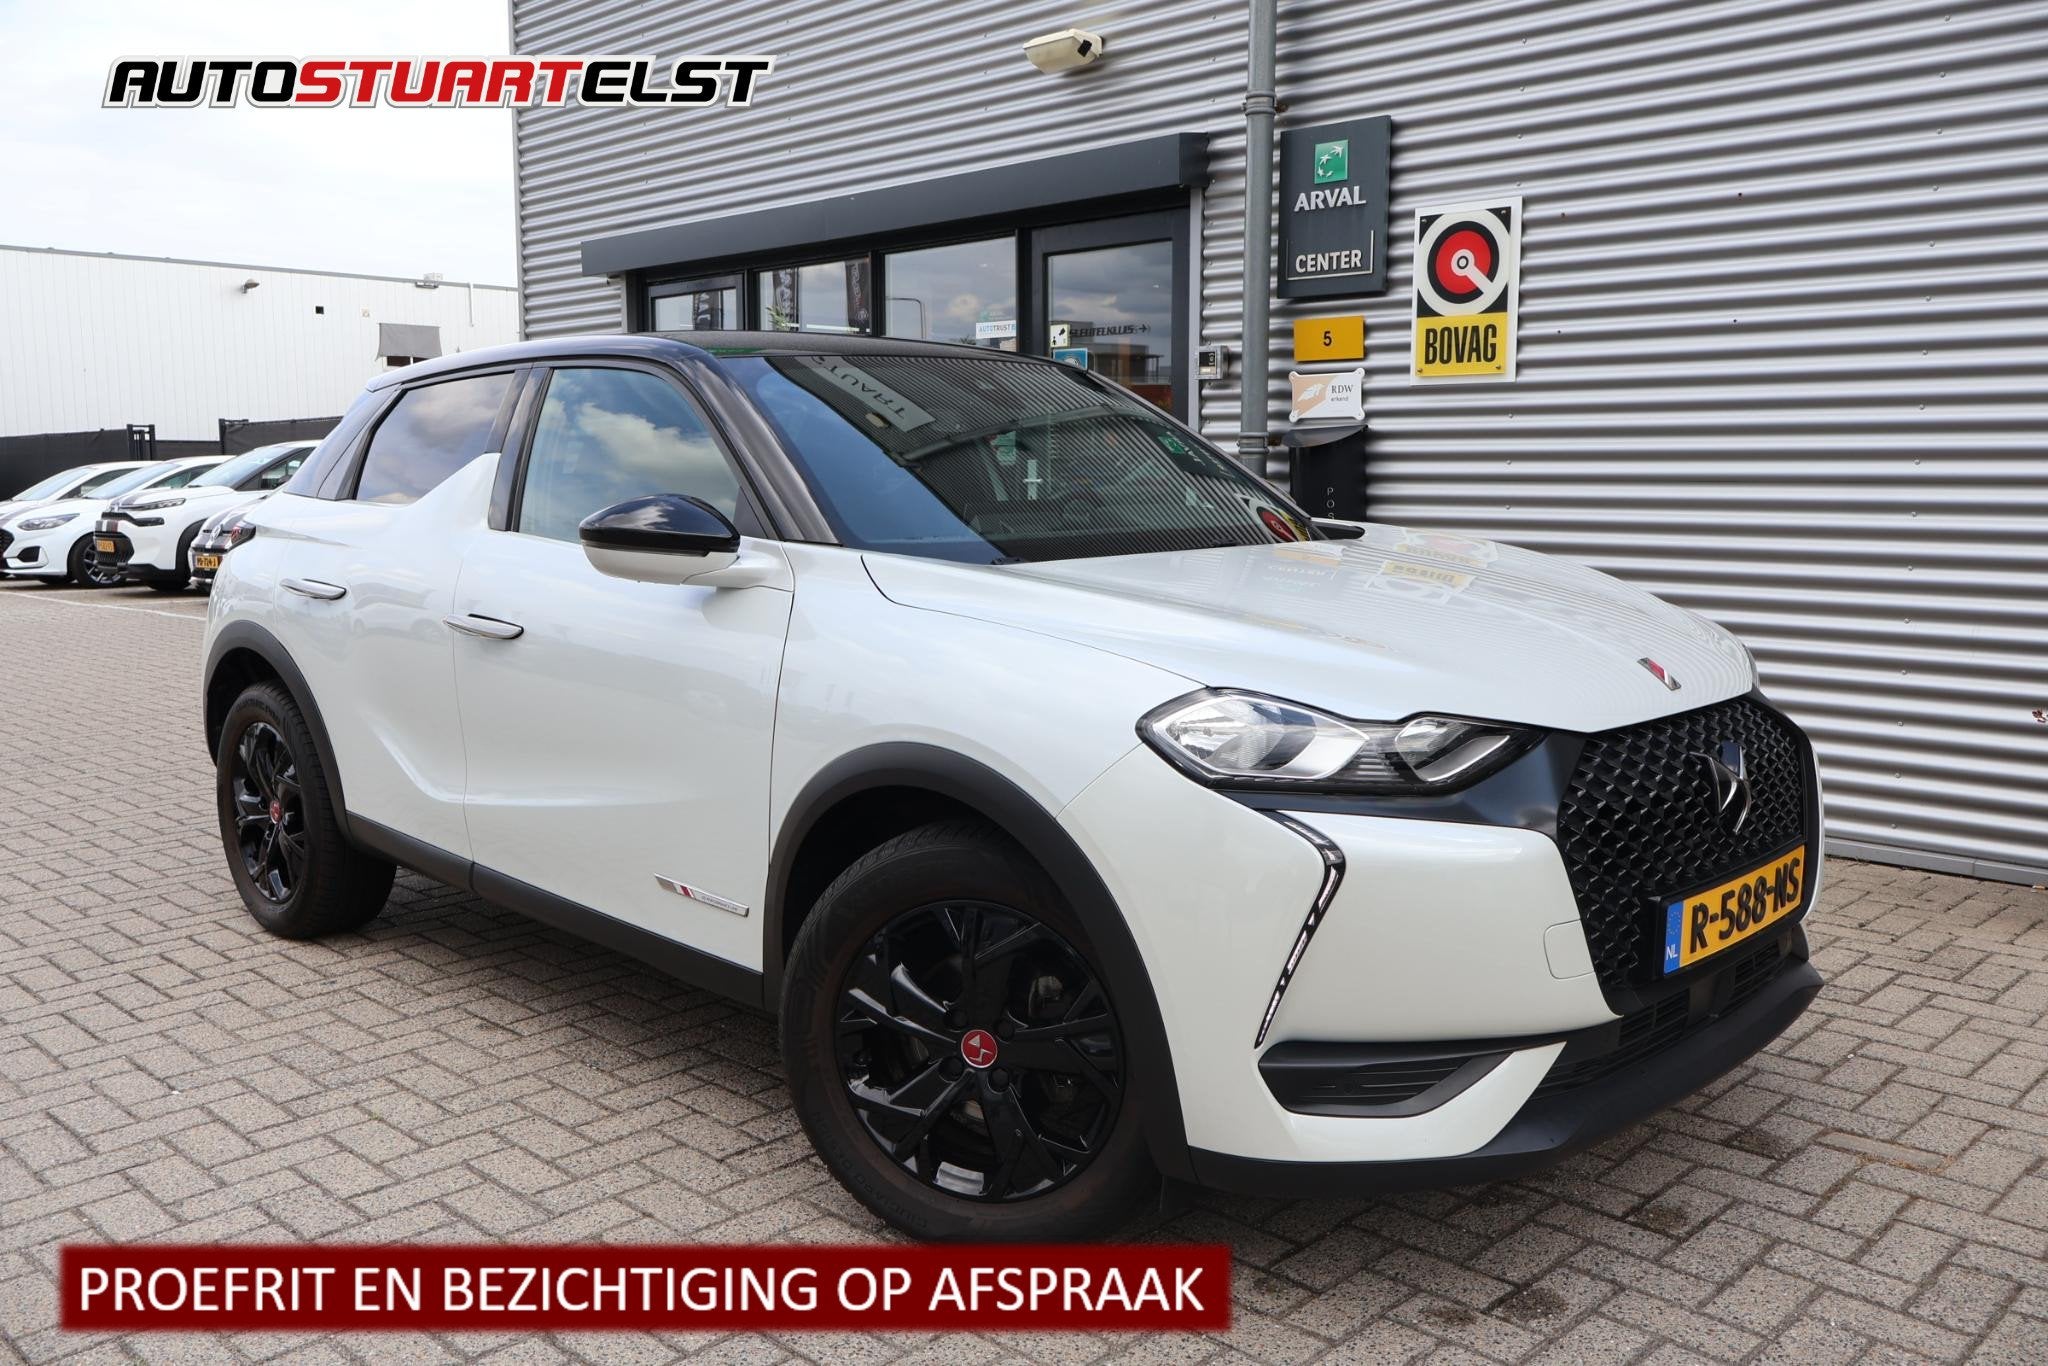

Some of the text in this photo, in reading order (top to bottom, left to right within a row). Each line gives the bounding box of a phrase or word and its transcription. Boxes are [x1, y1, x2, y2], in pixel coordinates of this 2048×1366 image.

[1294, 185, 1367, 211] ARVAL
[1295, 249, 1362, 274] CENTER
[1323, 330, 1332, 347] 5
[1424, 324, 1497, 365] BOVAG
[1331, 384, 1354, 394] RDW
[1689, 856, 1801, 954] R-588-NS
[1665, 943, 1679, 961] NL
